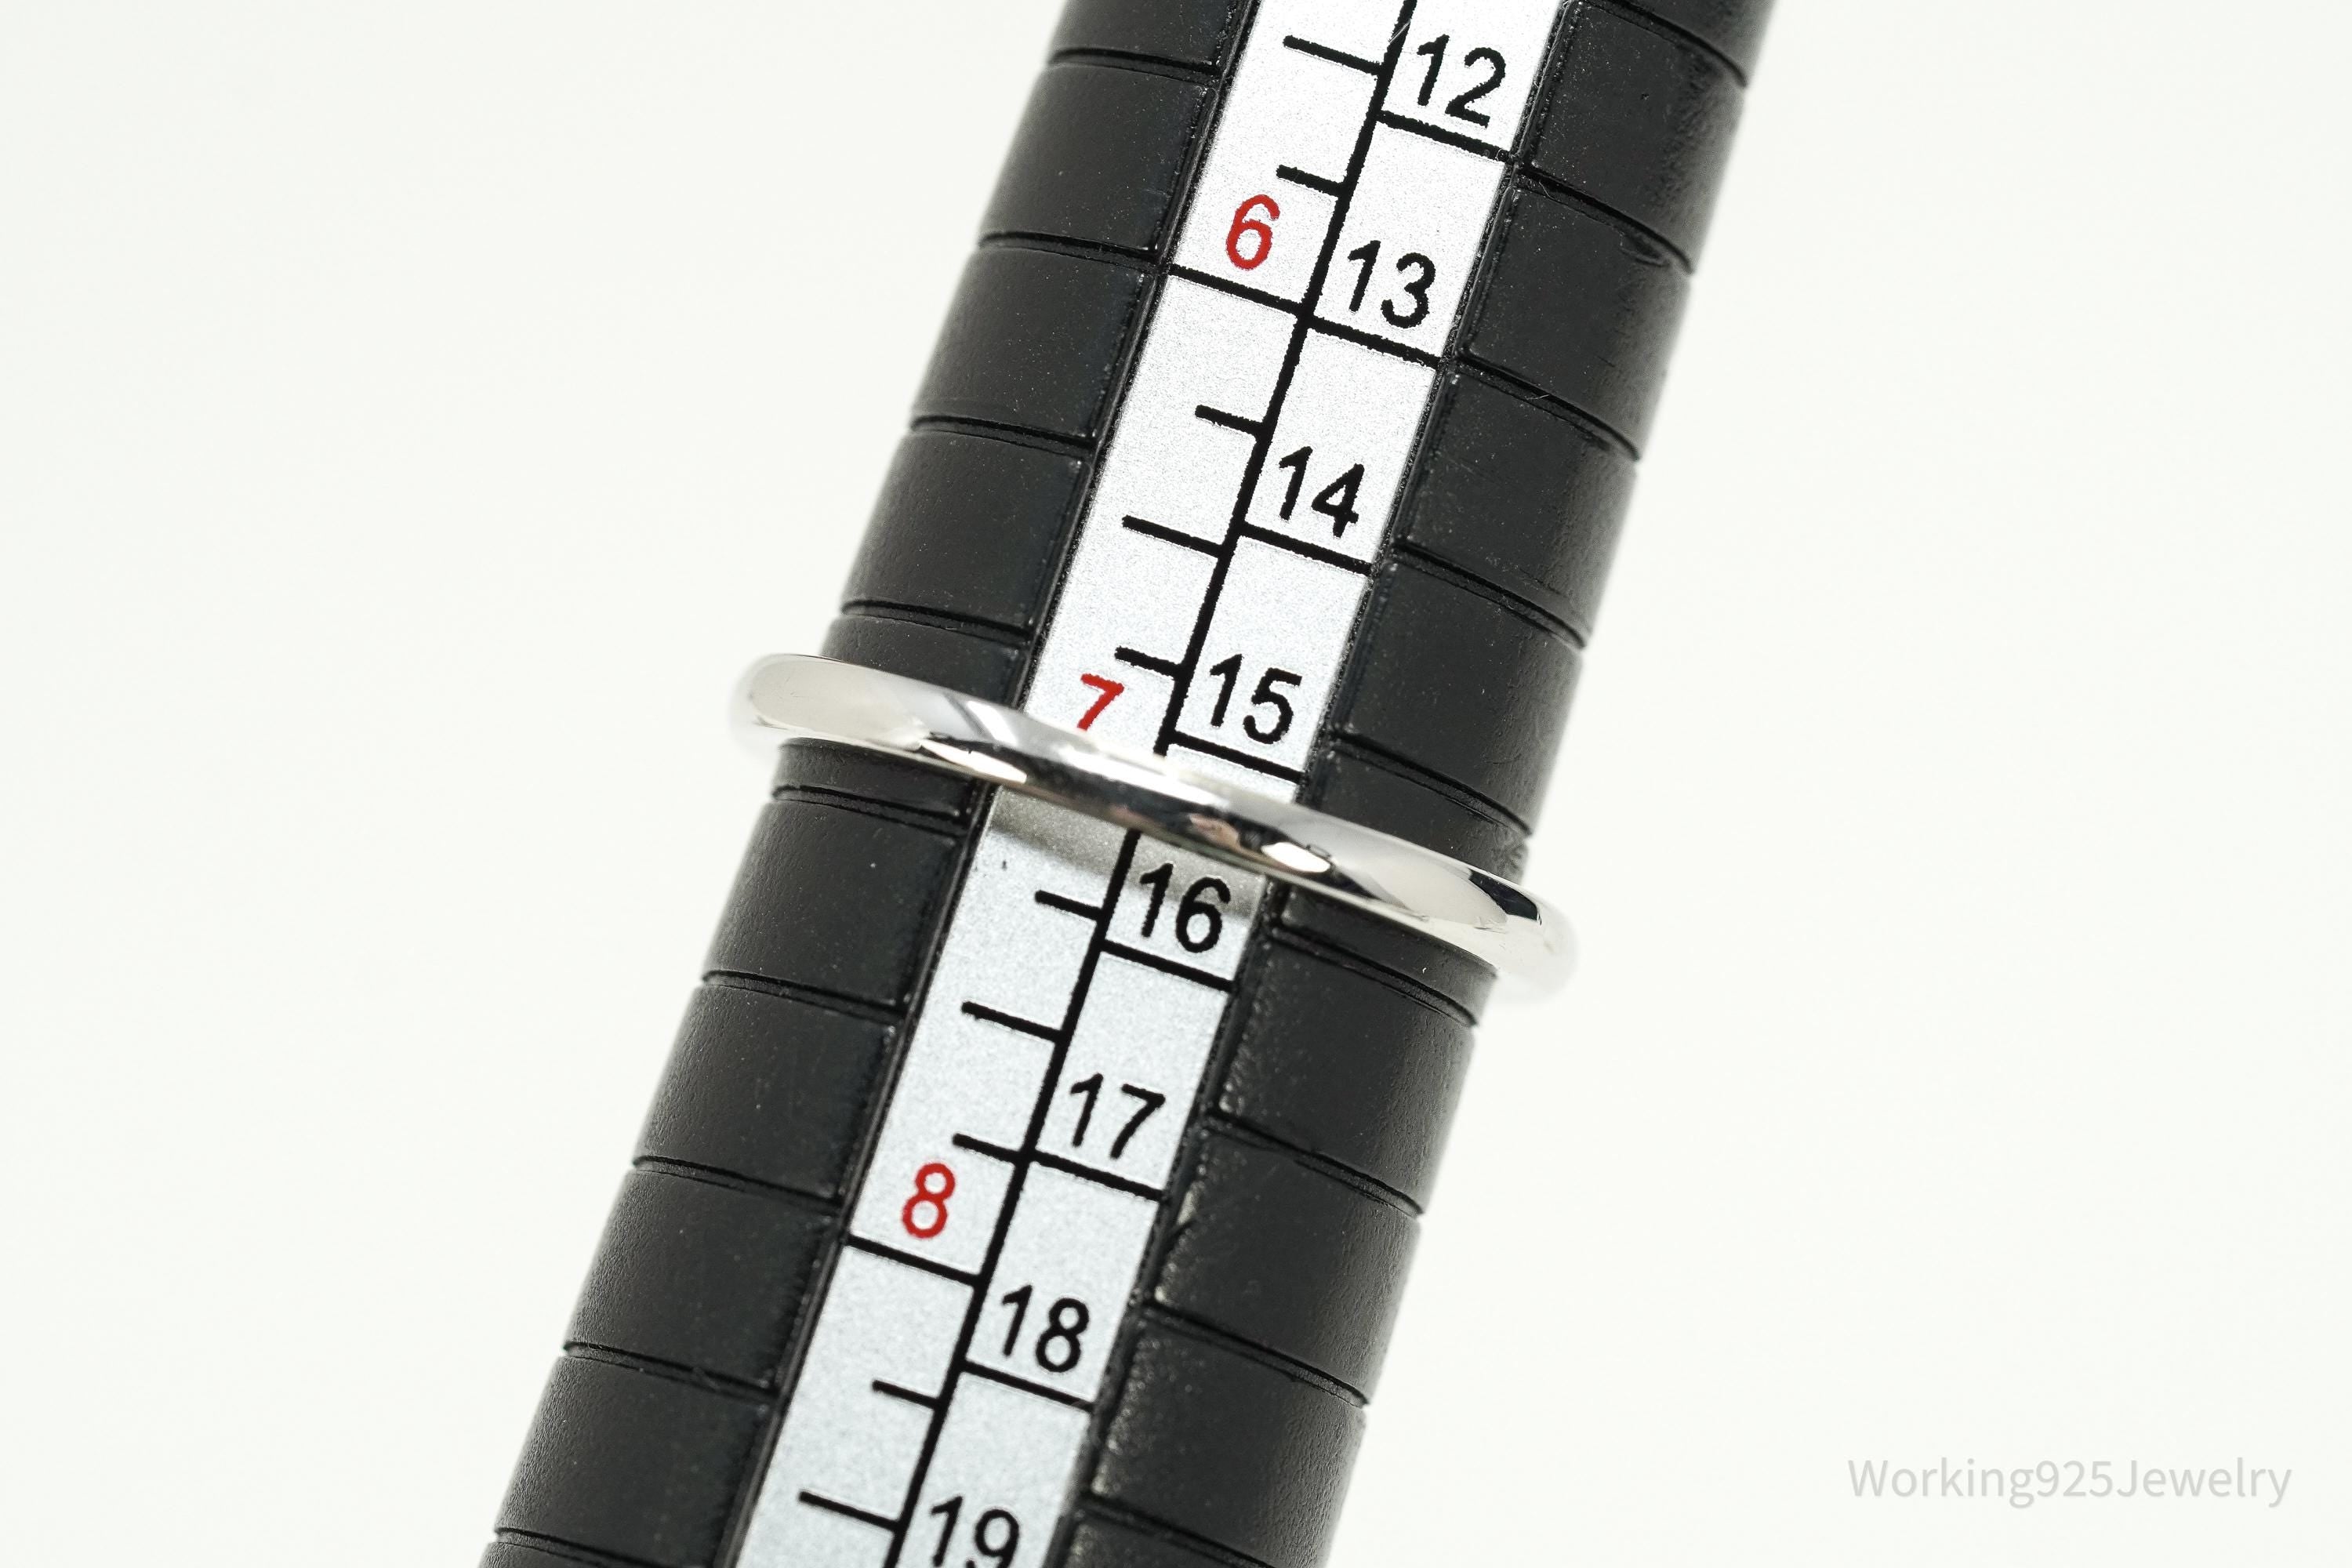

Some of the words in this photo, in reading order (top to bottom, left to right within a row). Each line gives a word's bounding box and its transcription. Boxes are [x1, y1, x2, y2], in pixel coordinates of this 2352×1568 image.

[1415, 34, 1508, 130] 12
[1225, 194, 1281, 271] 6
[1346, 240, 1437, 330] 13
[1277, 445, 1366, 539] 14
[1077, 673, 1125, 731] 7
[1208, 652, 1303, 745] 15
[1138, 862, 1232, 954] 16
[1069, 1073, 1167, 1160] 17
[902, 1162, 956, 1240] 8
[1000, 1284, 1091, 1374] 18
[930, 1495, 1022, 1568] 19
